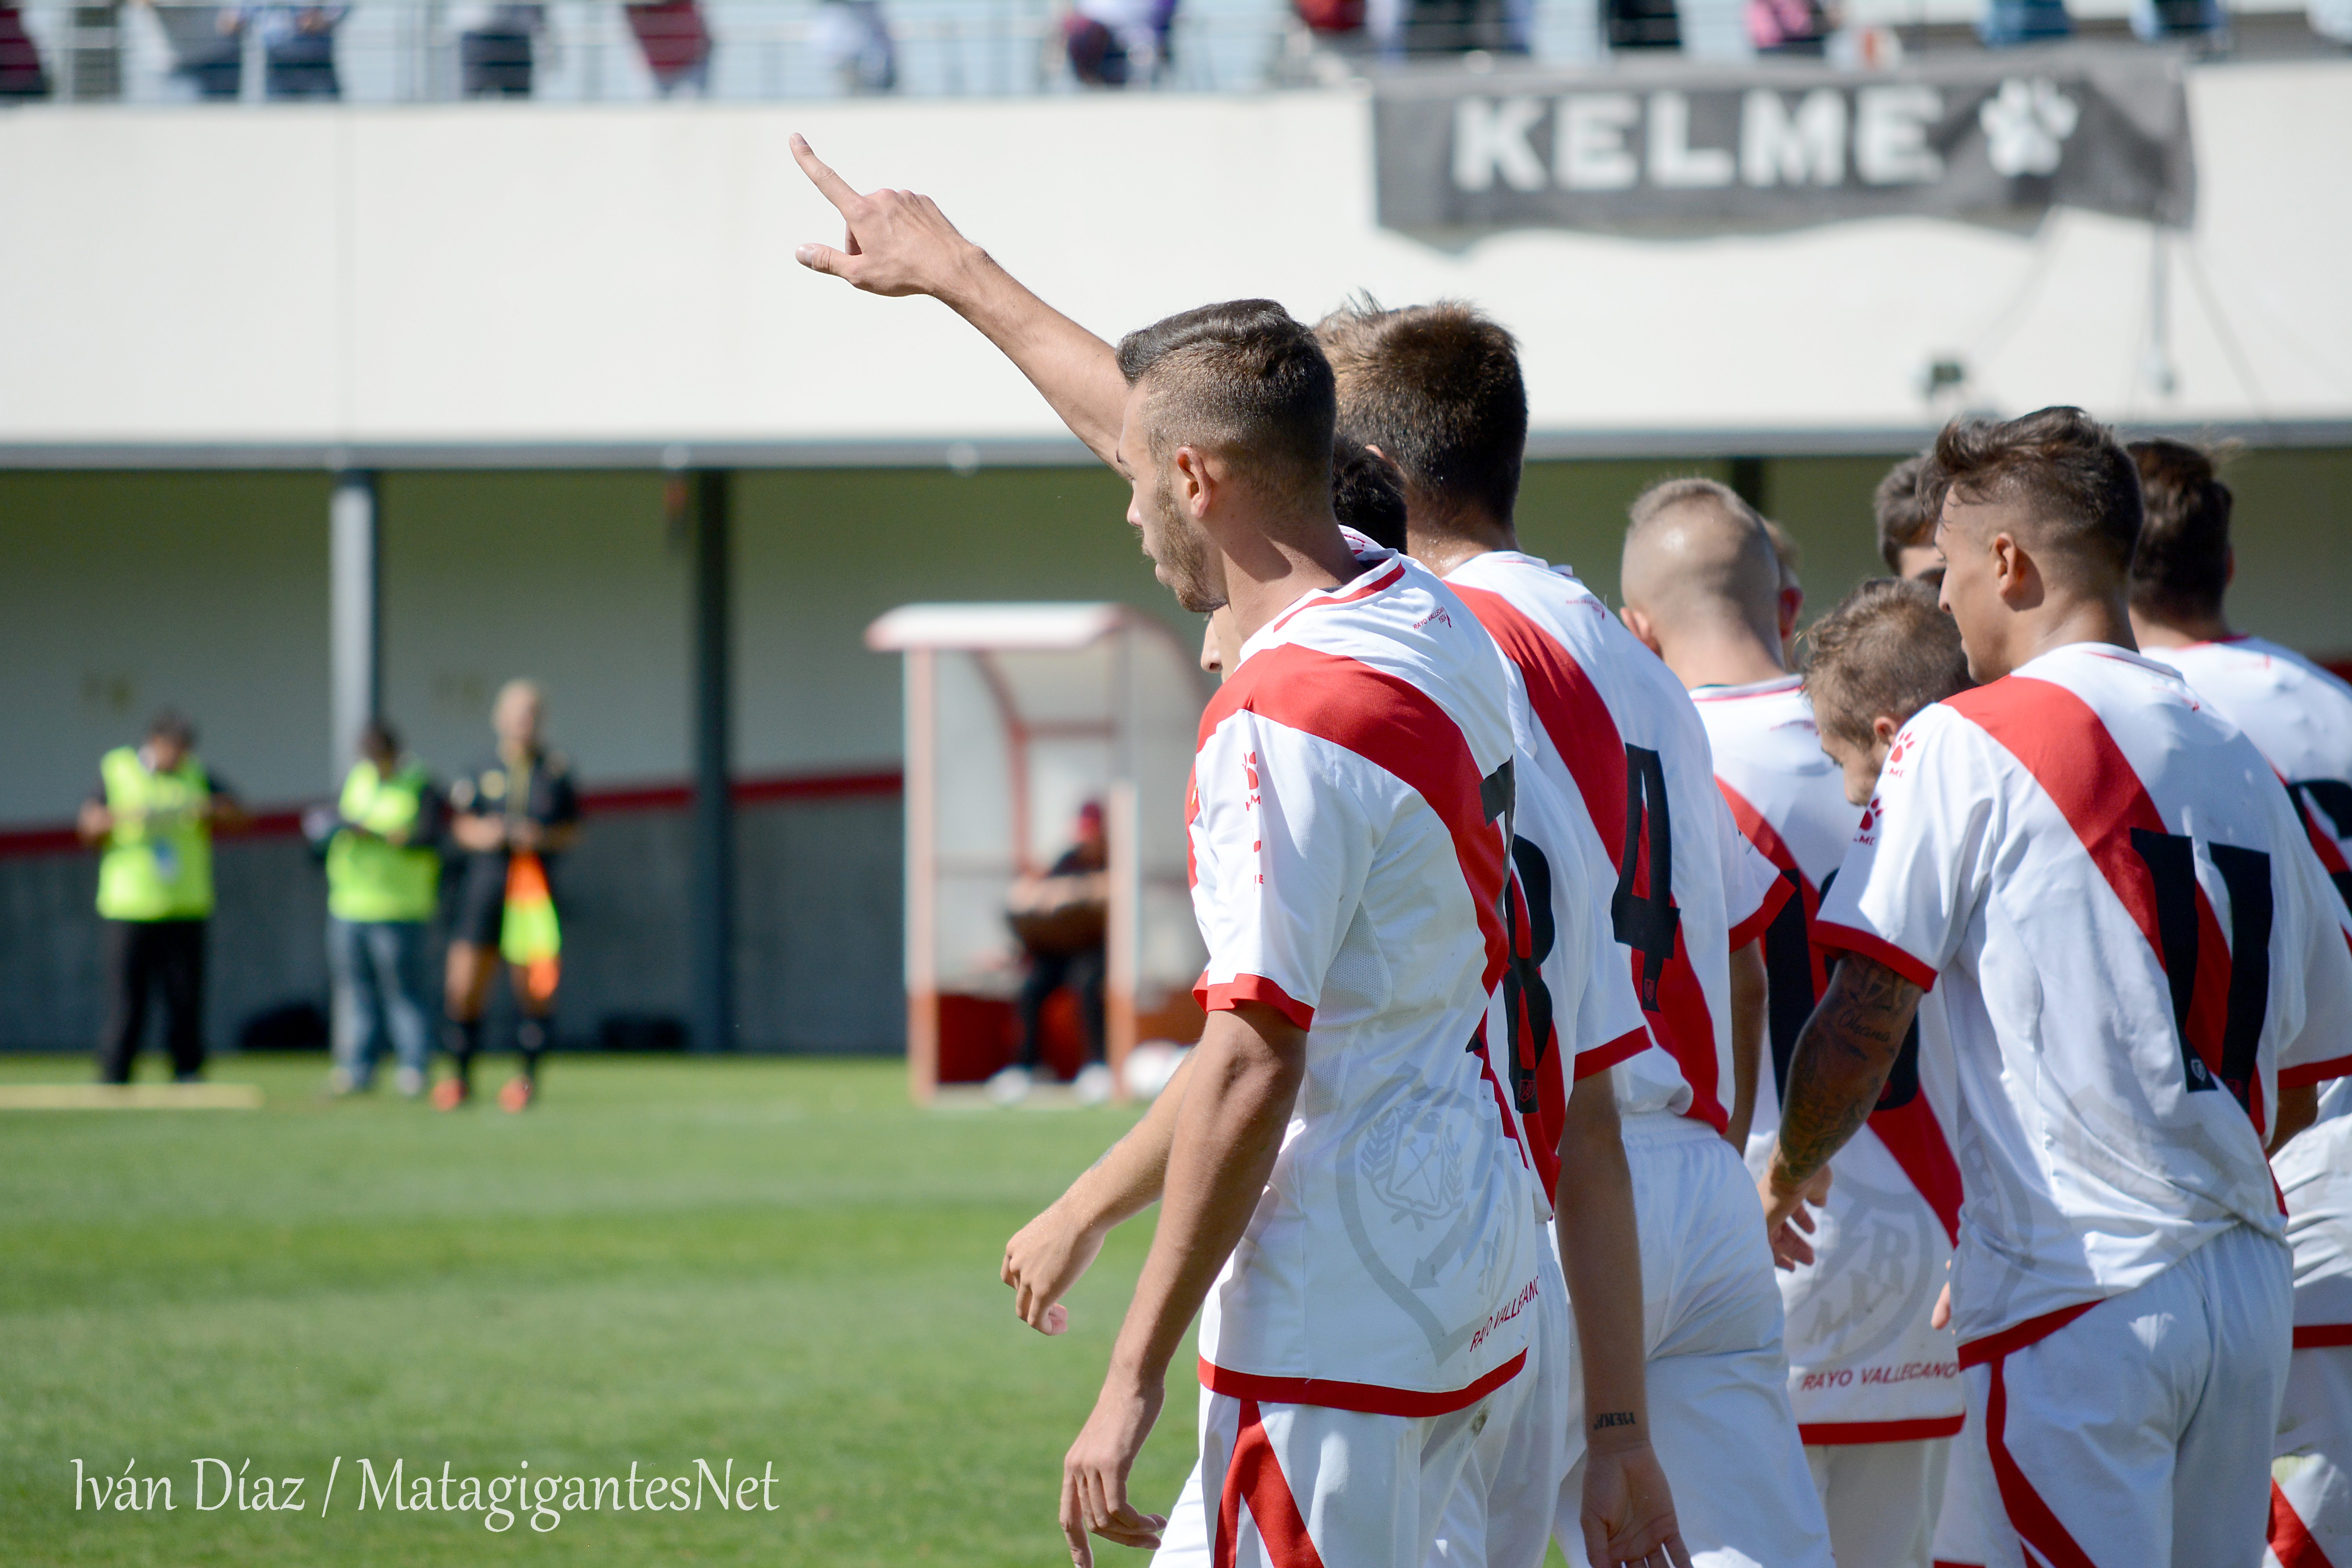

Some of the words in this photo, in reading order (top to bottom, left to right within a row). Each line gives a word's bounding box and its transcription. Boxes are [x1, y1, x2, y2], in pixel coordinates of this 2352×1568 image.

[1451, 87, 1945, 193] KELME
[1413, 618, 1427, 630] RAYO
[1611, 743, 1681, 1013] 4
[2130, 828, 2273, 1112] 11
[1493, 1275, 1539, 1329] VALLEAN
[1800, 1368, 1853, 1391] RAYO
[1861, 1362, 1959, 1385] VALLECANO
